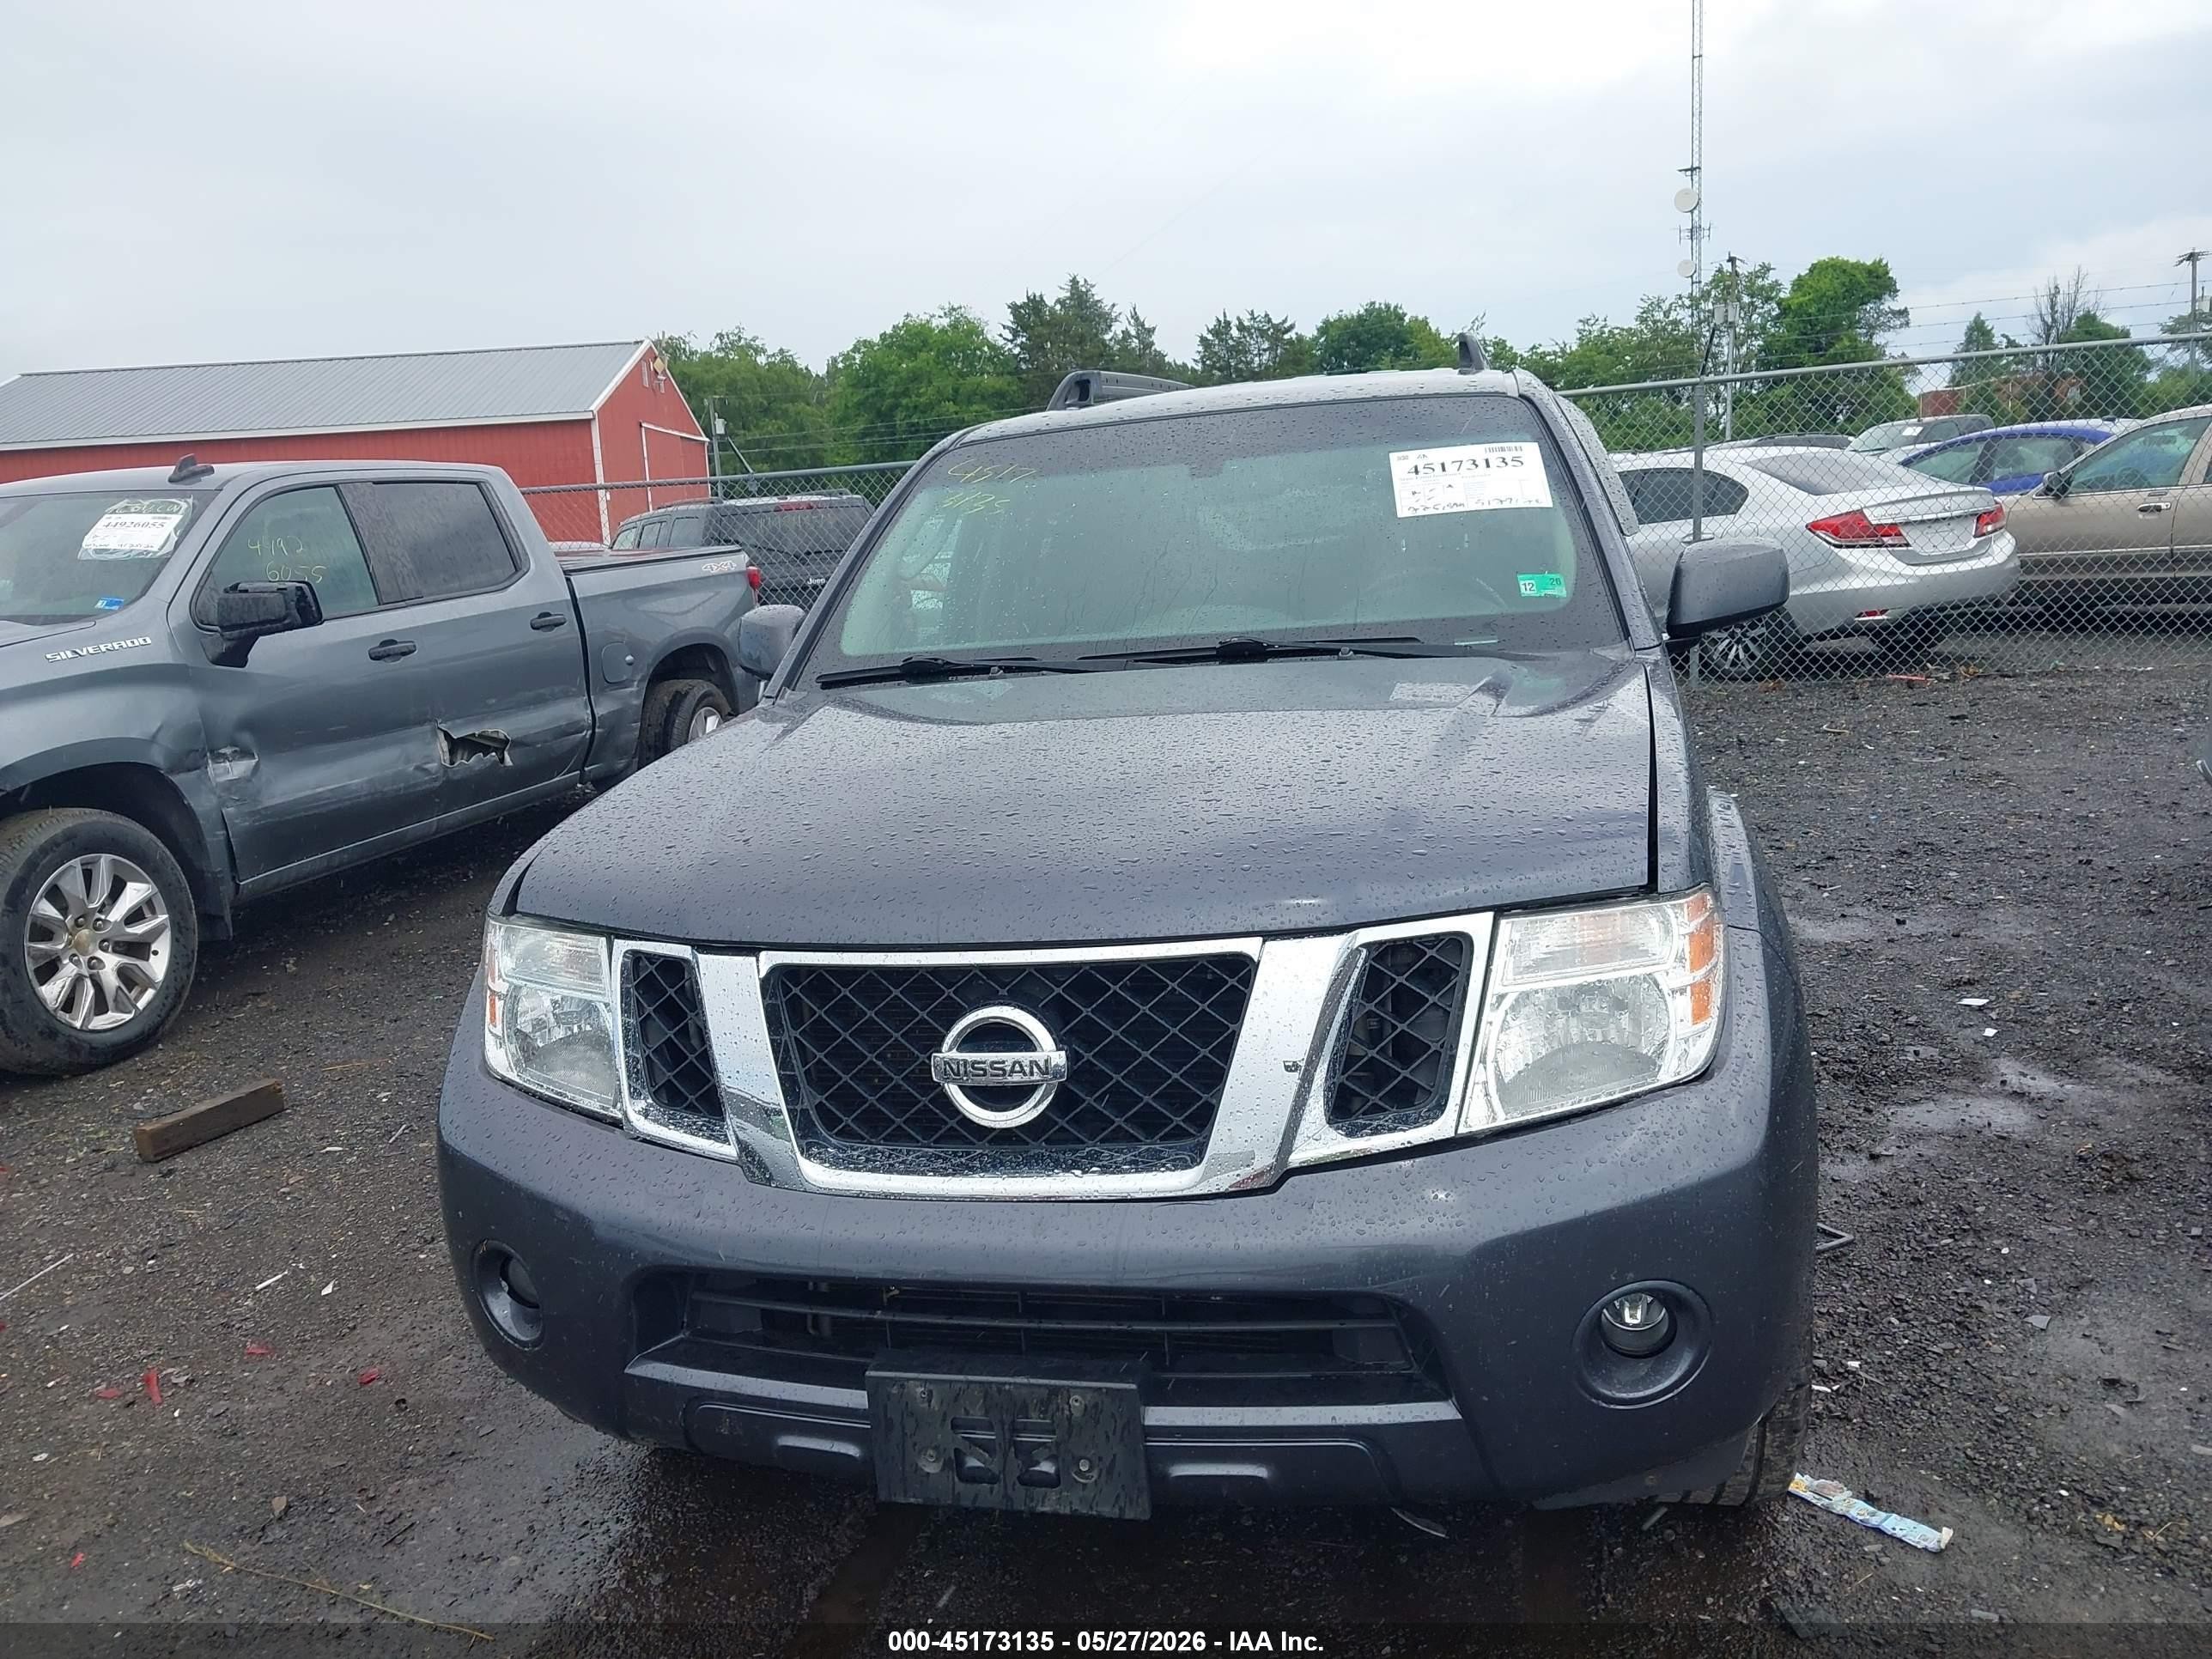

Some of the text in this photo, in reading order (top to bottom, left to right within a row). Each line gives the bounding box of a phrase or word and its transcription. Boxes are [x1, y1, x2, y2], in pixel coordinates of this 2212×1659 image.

[1407, 455, 1525, 476] 45173135
[102, 520, 167, 530] 44926055
[1522, 582, 1535, 592] 12
[45, 636, 152, 663] SILVERADO
[943, 1056, 1052, 1079] NISSAN
